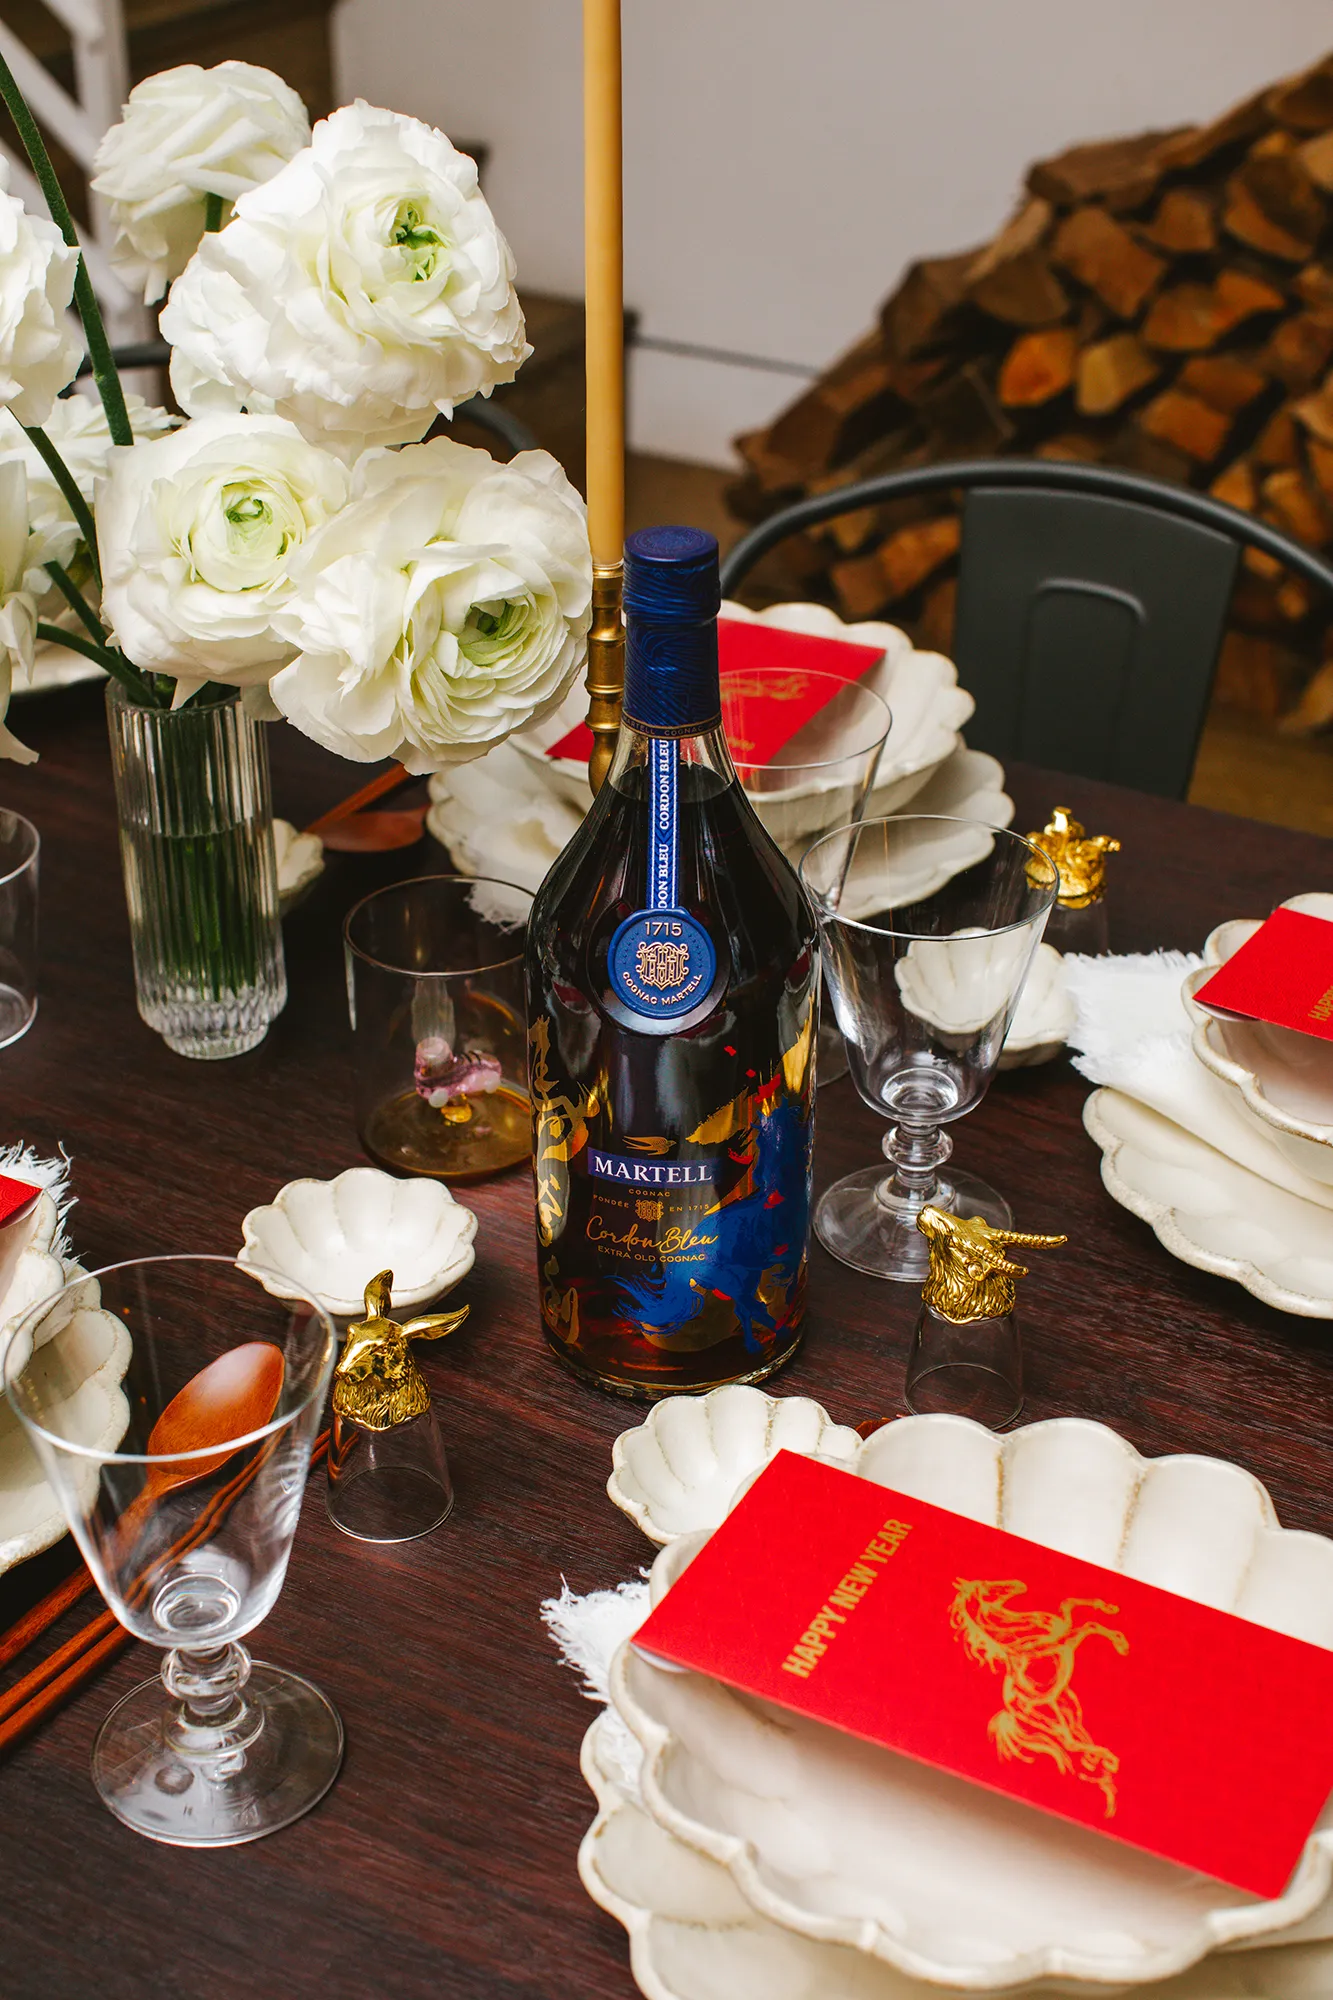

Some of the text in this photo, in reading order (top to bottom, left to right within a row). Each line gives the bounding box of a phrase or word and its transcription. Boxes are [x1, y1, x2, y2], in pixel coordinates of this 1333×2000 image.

[664, 726, 703, 736] COGNAC
[660, 740, 669, 829] CORDON BLEU
[659, 844, 669, 876] BLEU
[645, 922, 682, 936] 1715
[623, 971, 702, 1005] COGNAC MARTELL
[1307, 985, 1333, 1021] HAPP
[595, 1156, 711, 1183] MARTELL
[628, 1188, 671, 1197] COGNAC
[688, 1203, 709, 1211] 1715
[586, 1215, 718, 1254] Cordon Bleu
[597, 1245, 705, 1263] EXTRA OLD COGNAC
[782, 1519, 912, 1678] HAPPY NEW YEAR
